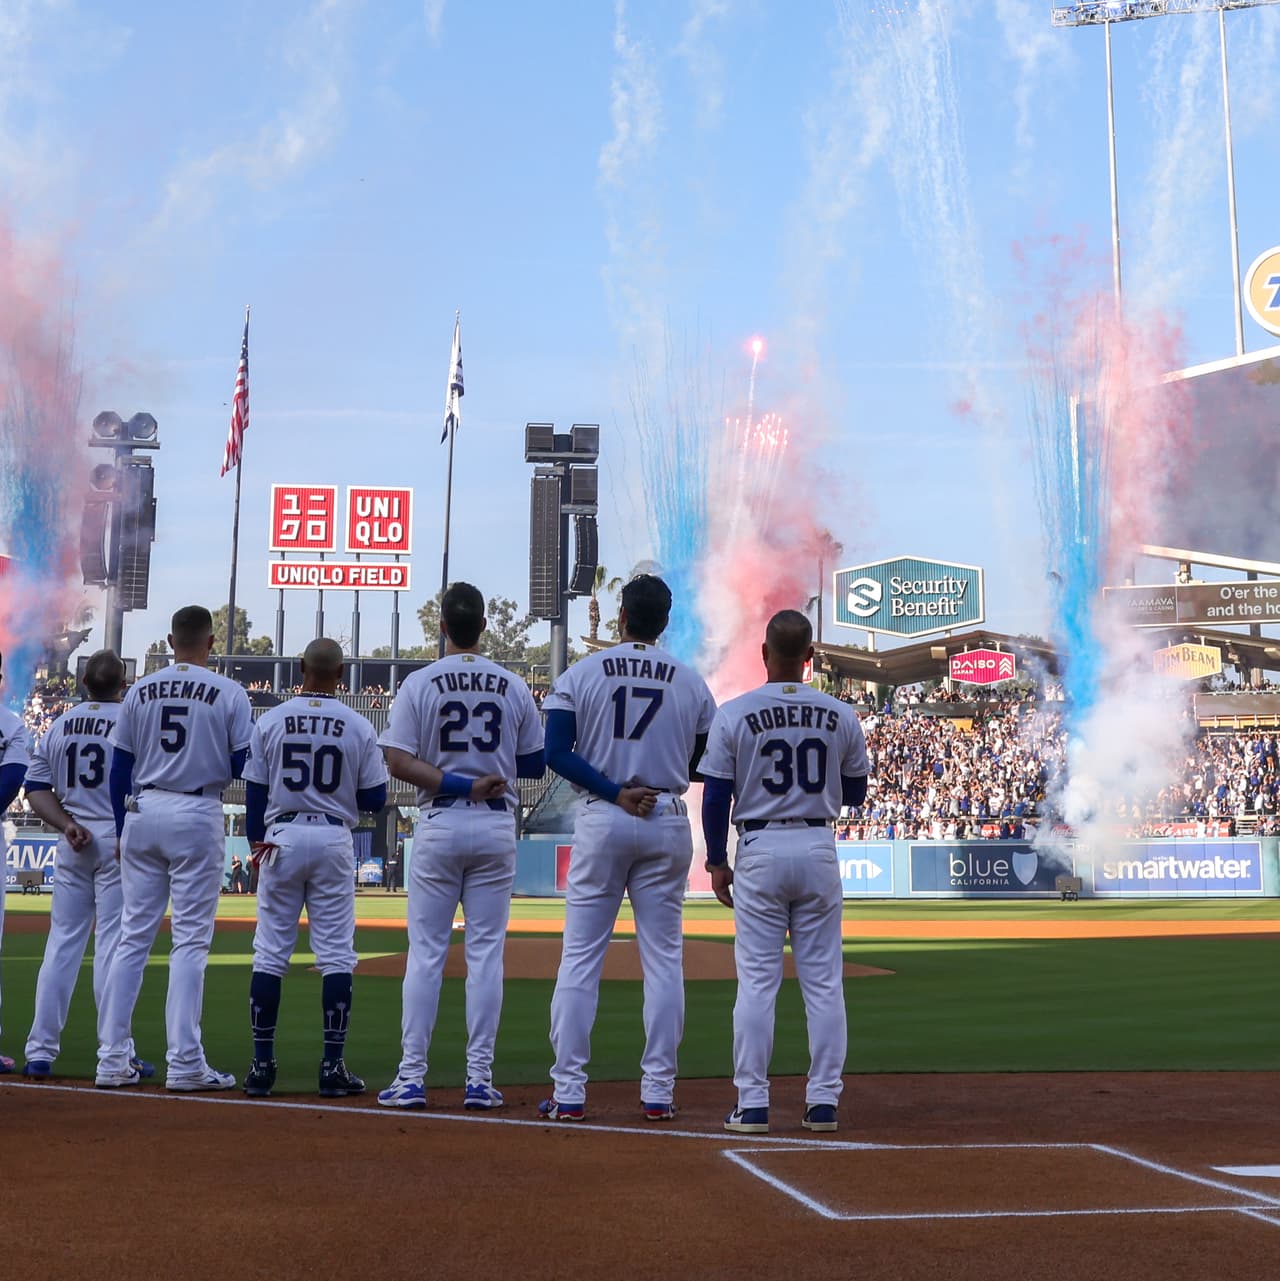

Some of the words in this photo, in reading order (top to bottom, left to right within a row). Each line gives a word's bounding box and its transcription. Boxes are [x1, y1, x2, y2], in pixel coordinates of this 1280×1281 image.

[282, 494, 326, 515] ユニ
[357, 496, 399, 518] UNI
[279, 520, 326, 541] クロ
[356, 522, 403, 546] QLO
[277, 567, 343, 586] UNIQLO
[349, 568, 402, 585] FIELD
[890, 575, 968, 598] Security
[1253, 586, 1277, 598] the
[891, 598, 960, 617] Benefit
[1207, 603, 1234, 617] and
[1238, 603, 1262, 616] the
[602, 658, 676, 684] OHTANI
[952, 659, 996, 669] DAISO
[138, 680, 221, 707] FREEMAN
[431, 672, 509, 697] TUCKER
[611, 685, 664, 741] 17
[745, 705, 839, 736] ROBERTS
[63, 718, 116, 738] MUNCY
[159, 705, 190, 753] 5
[285, 716, 345, 738] BETTS
[439, 701, 503, 753] 23
[65, 742, 105, 789] 13
[282, 742, 344, 794] 50
[761, 738, 828, 795] 30
[6, 845, 57, 869] ANA
[949, 853, 1009, 877] blue
[950, 878, 1009, 886] CALIFORNIA
